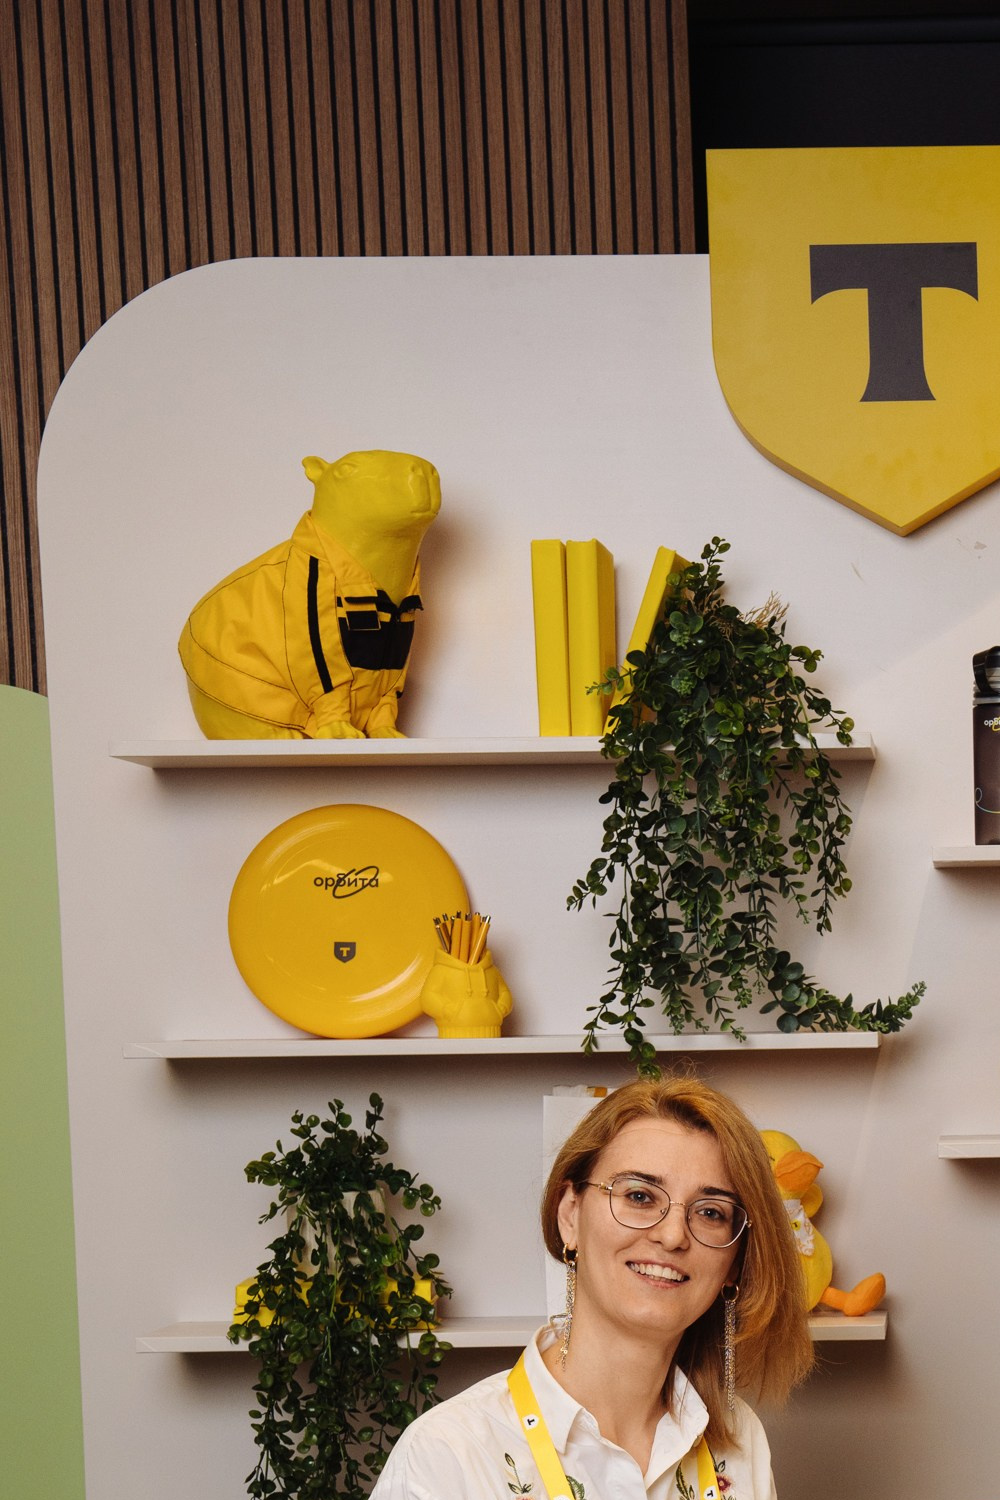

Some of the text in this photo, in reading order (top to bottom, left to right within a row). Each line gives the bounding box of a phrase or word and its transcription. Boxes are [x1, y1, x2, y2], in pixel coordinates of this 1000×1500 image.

[809, 242, 978, 402] Т
[313, 872, 379, 891] орбита
[339, 947, 351, 958] Т
